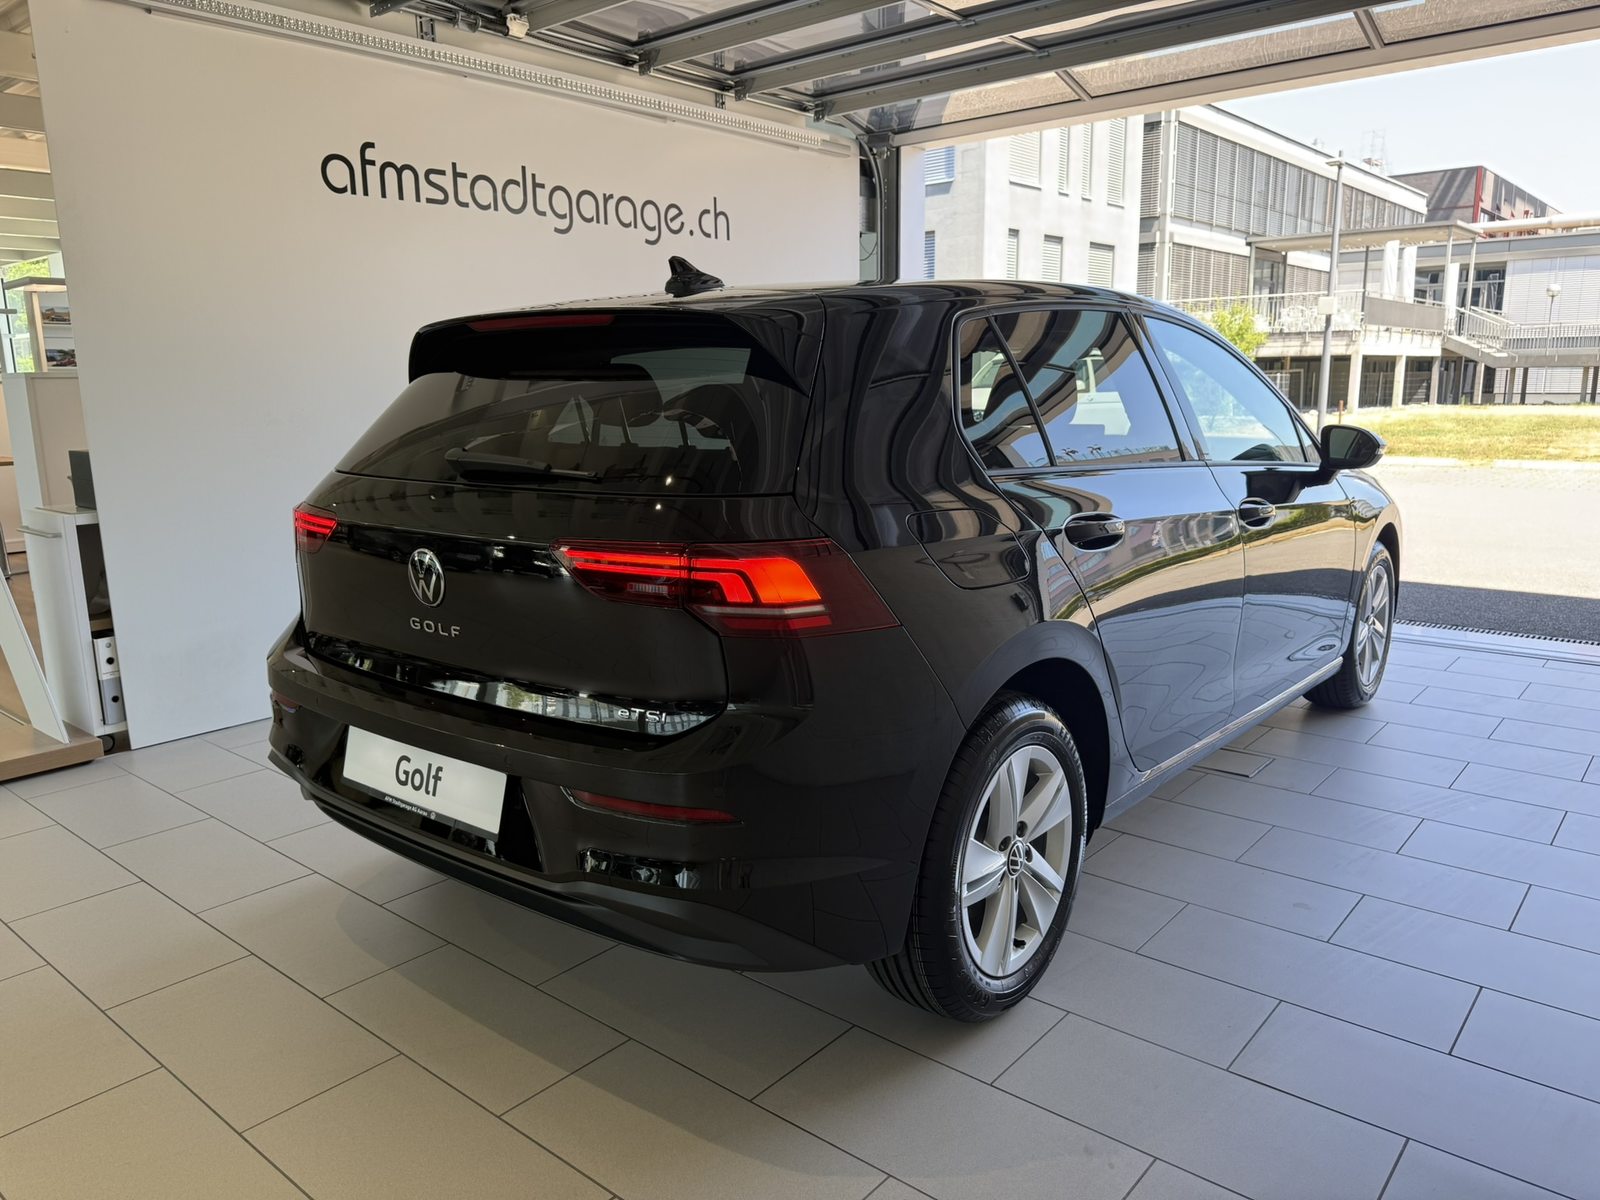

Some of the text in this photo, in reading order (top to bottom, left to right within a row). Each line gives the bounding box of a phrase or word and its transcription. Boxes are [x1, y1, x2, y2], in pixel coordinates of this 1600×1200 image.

[320, 141, 731, 247] afmstadtgarage.ch
[409, 617, 461, 638] GOLF
[617, 707, 667, 725] eTSI
[395, 754, 443, 797] Golf
